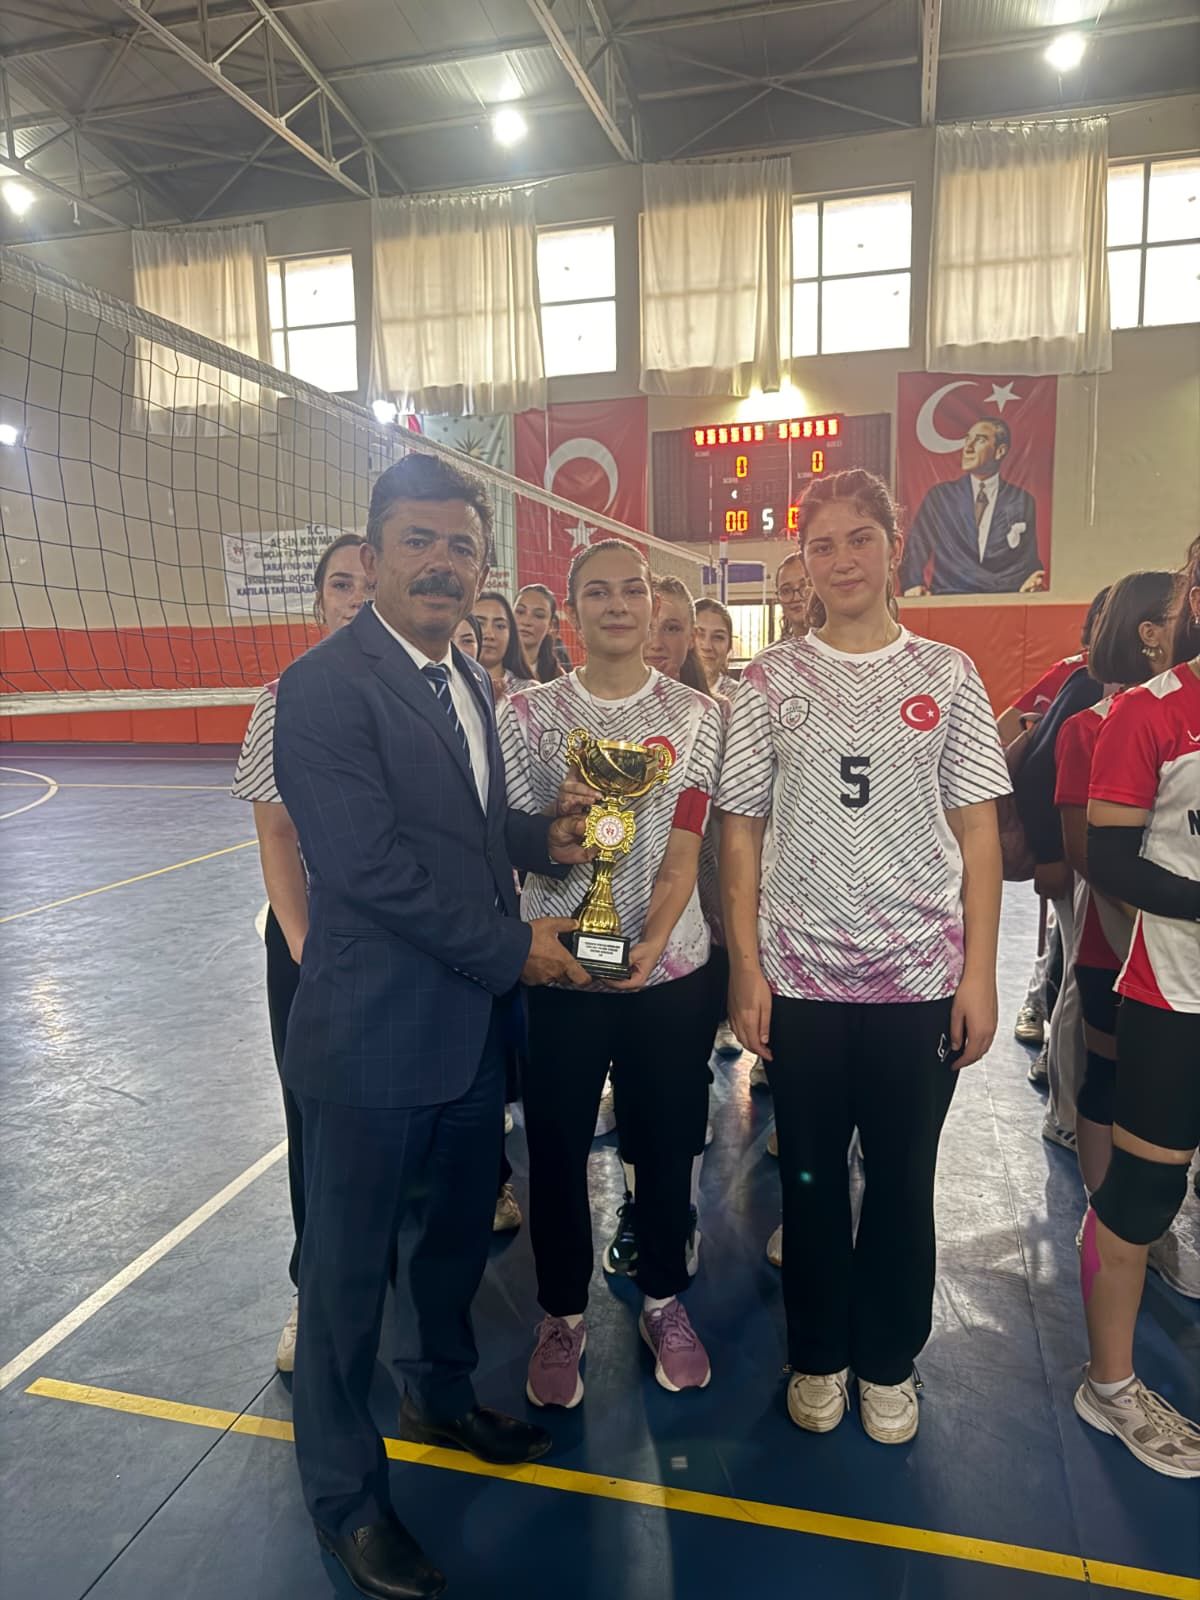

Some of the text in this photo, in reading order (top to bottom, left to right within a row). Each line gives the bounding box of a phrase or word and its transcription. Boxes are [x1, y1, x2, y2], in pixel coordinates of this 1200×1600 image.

[736, 456, 748, 478] 0
[812, 450, 824, 473] 0
[725, 511, 748, 532] 00
[301, 535, 337, 547] KAYMA
[840, 756, 871, 808] 5
